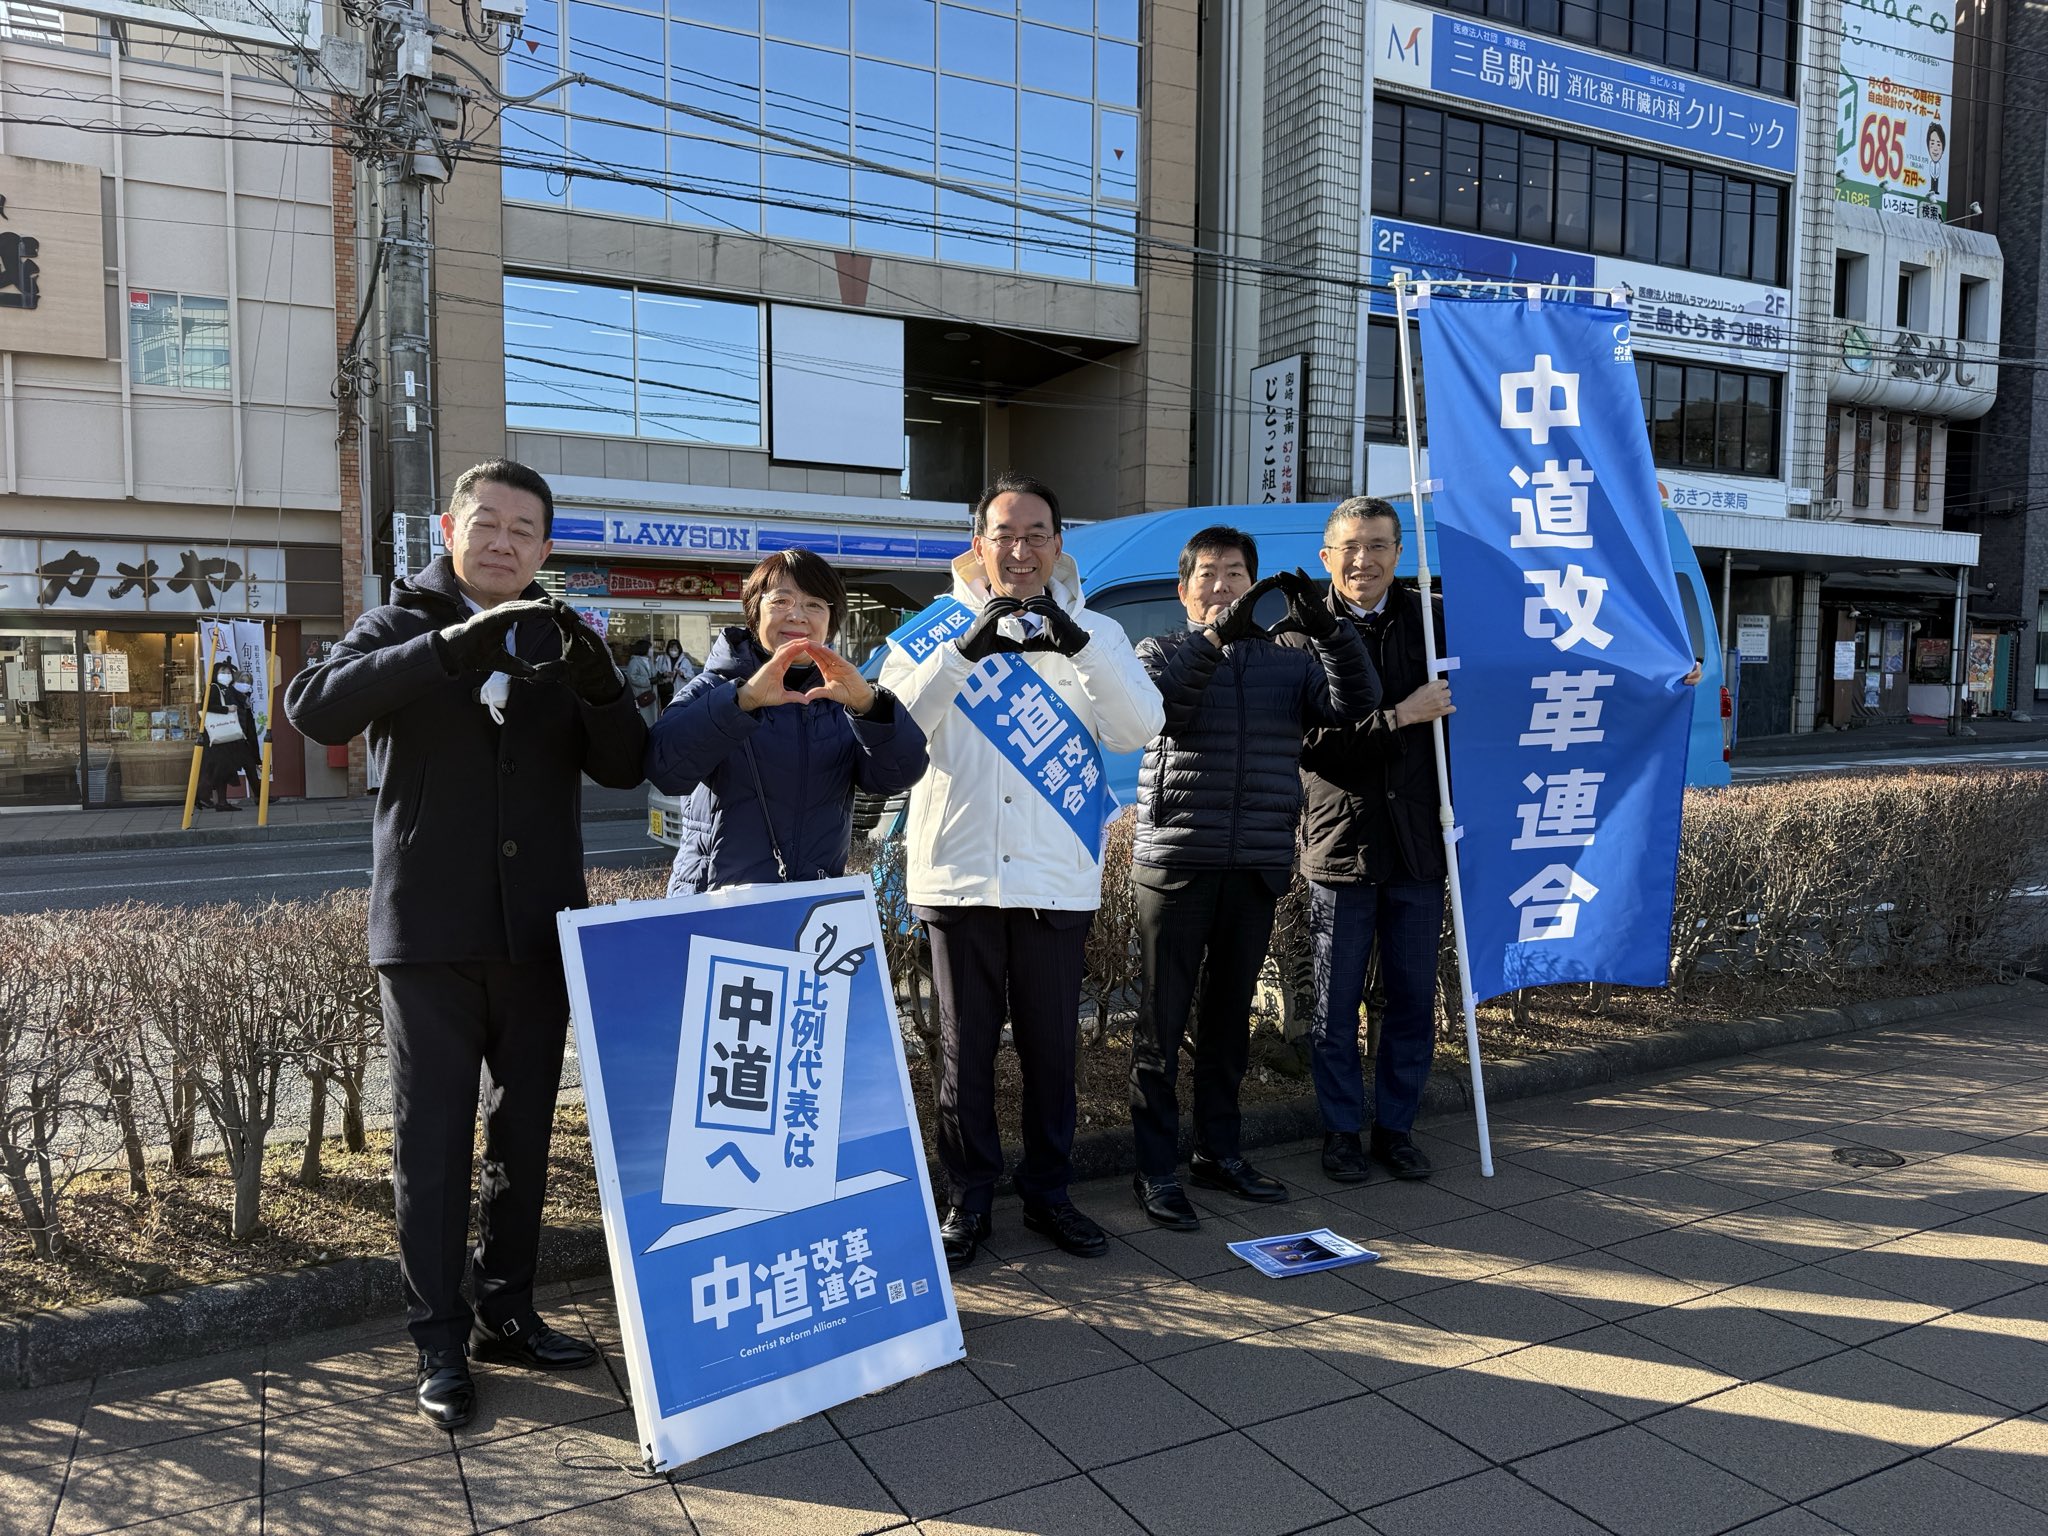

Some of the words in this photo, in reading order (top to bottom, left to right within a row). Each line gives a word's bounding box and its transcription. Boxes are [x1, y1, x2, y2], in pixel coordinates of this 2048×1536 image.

[1453, 23, 1498, 44] 医療法人社団
[1451, 39, 1560, 99] 三島駅前
[1567, 72, 1681, 122] 消化器・肝臓内科
[1686, 98, 1785, 149] クリニック
[1868, 91, 1941, 120] 自由設計のマイホーム
[1860, 113, 1906, 180] 685
[1883, 198, 1915, 215] いろはこ
[1922, 205, 1938, 220] 検索
[1378, 228, 1405, 254] 2F
[1636, 304, 1781, 350] 三島むらまつ眼科
[1765, 294, 1785, 315] 2F
[1673, 488, 1748, 510] あきつき薬局
[613, 521, 751, 551] LAWSON
[35, 549, 243, 610] カメヤ
[908, 609, 972, 659] 比例区
[1500, 354, 1615, 943] 中道改革連合
[960, 653, 1069, 768] 中道
[1037, 756, 1086, 816] 連合
[1059, 734, 1100, 794] 改革
[783, 967, 829, 1169] 比例代表は
[809, 1227, 873, 1274] 改革
[691, 1248, 813, 1335] 中道
[817, 1264, 878, 1313] 連合
[739, 1336, 778, 1358] Centrist
[779, 1328, 812, 1346] Reform
[812, 1315, 848, 1336] Alliance
